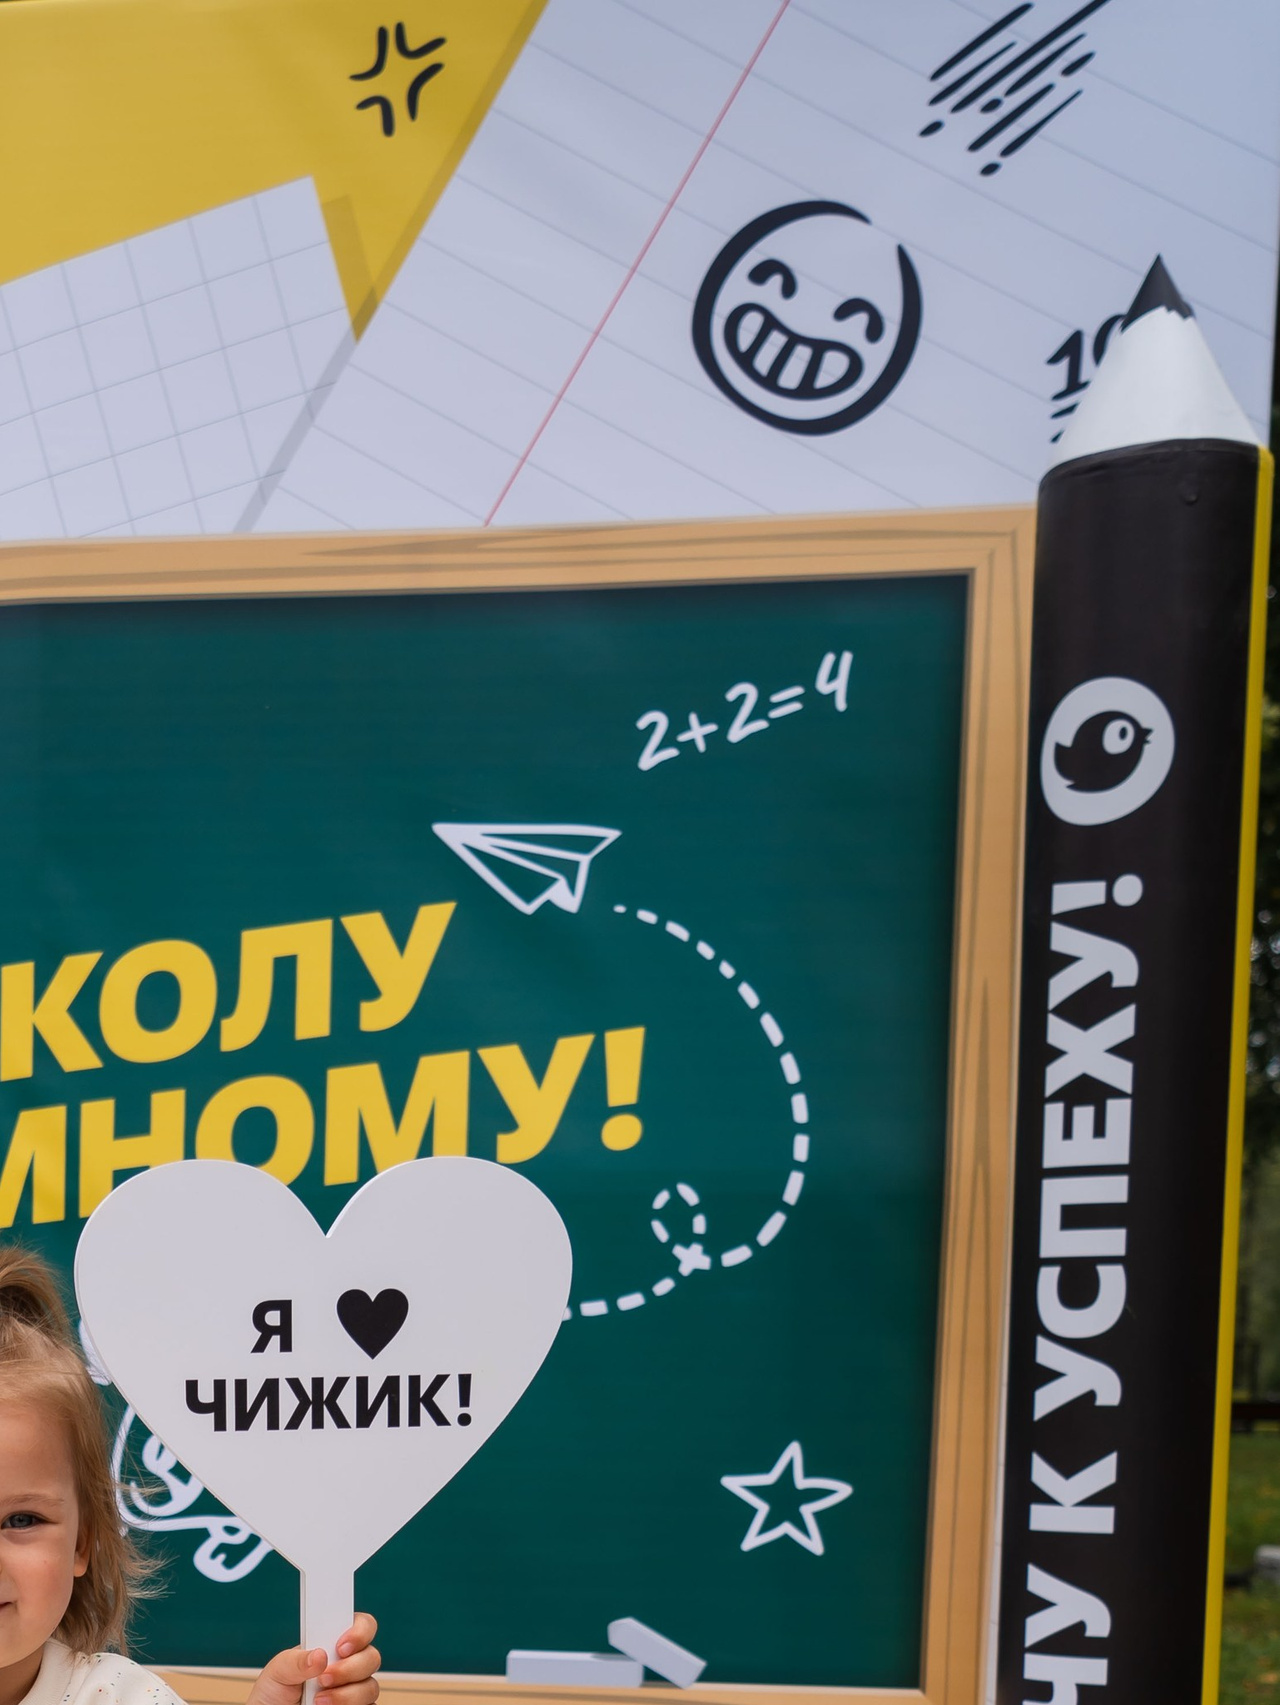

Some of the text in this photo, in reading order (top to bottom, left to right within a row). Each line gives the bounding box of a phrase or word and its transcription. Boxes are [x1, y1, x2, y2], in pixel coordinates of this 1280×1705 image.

[1033, 873, 1144, 1423] УСПЕХУ!
[250, 1299, 293, 1354] Я
[184, 1372, 473, 1433] ЧИЖИК!
[1029, 1450, 1118, 1535] К
